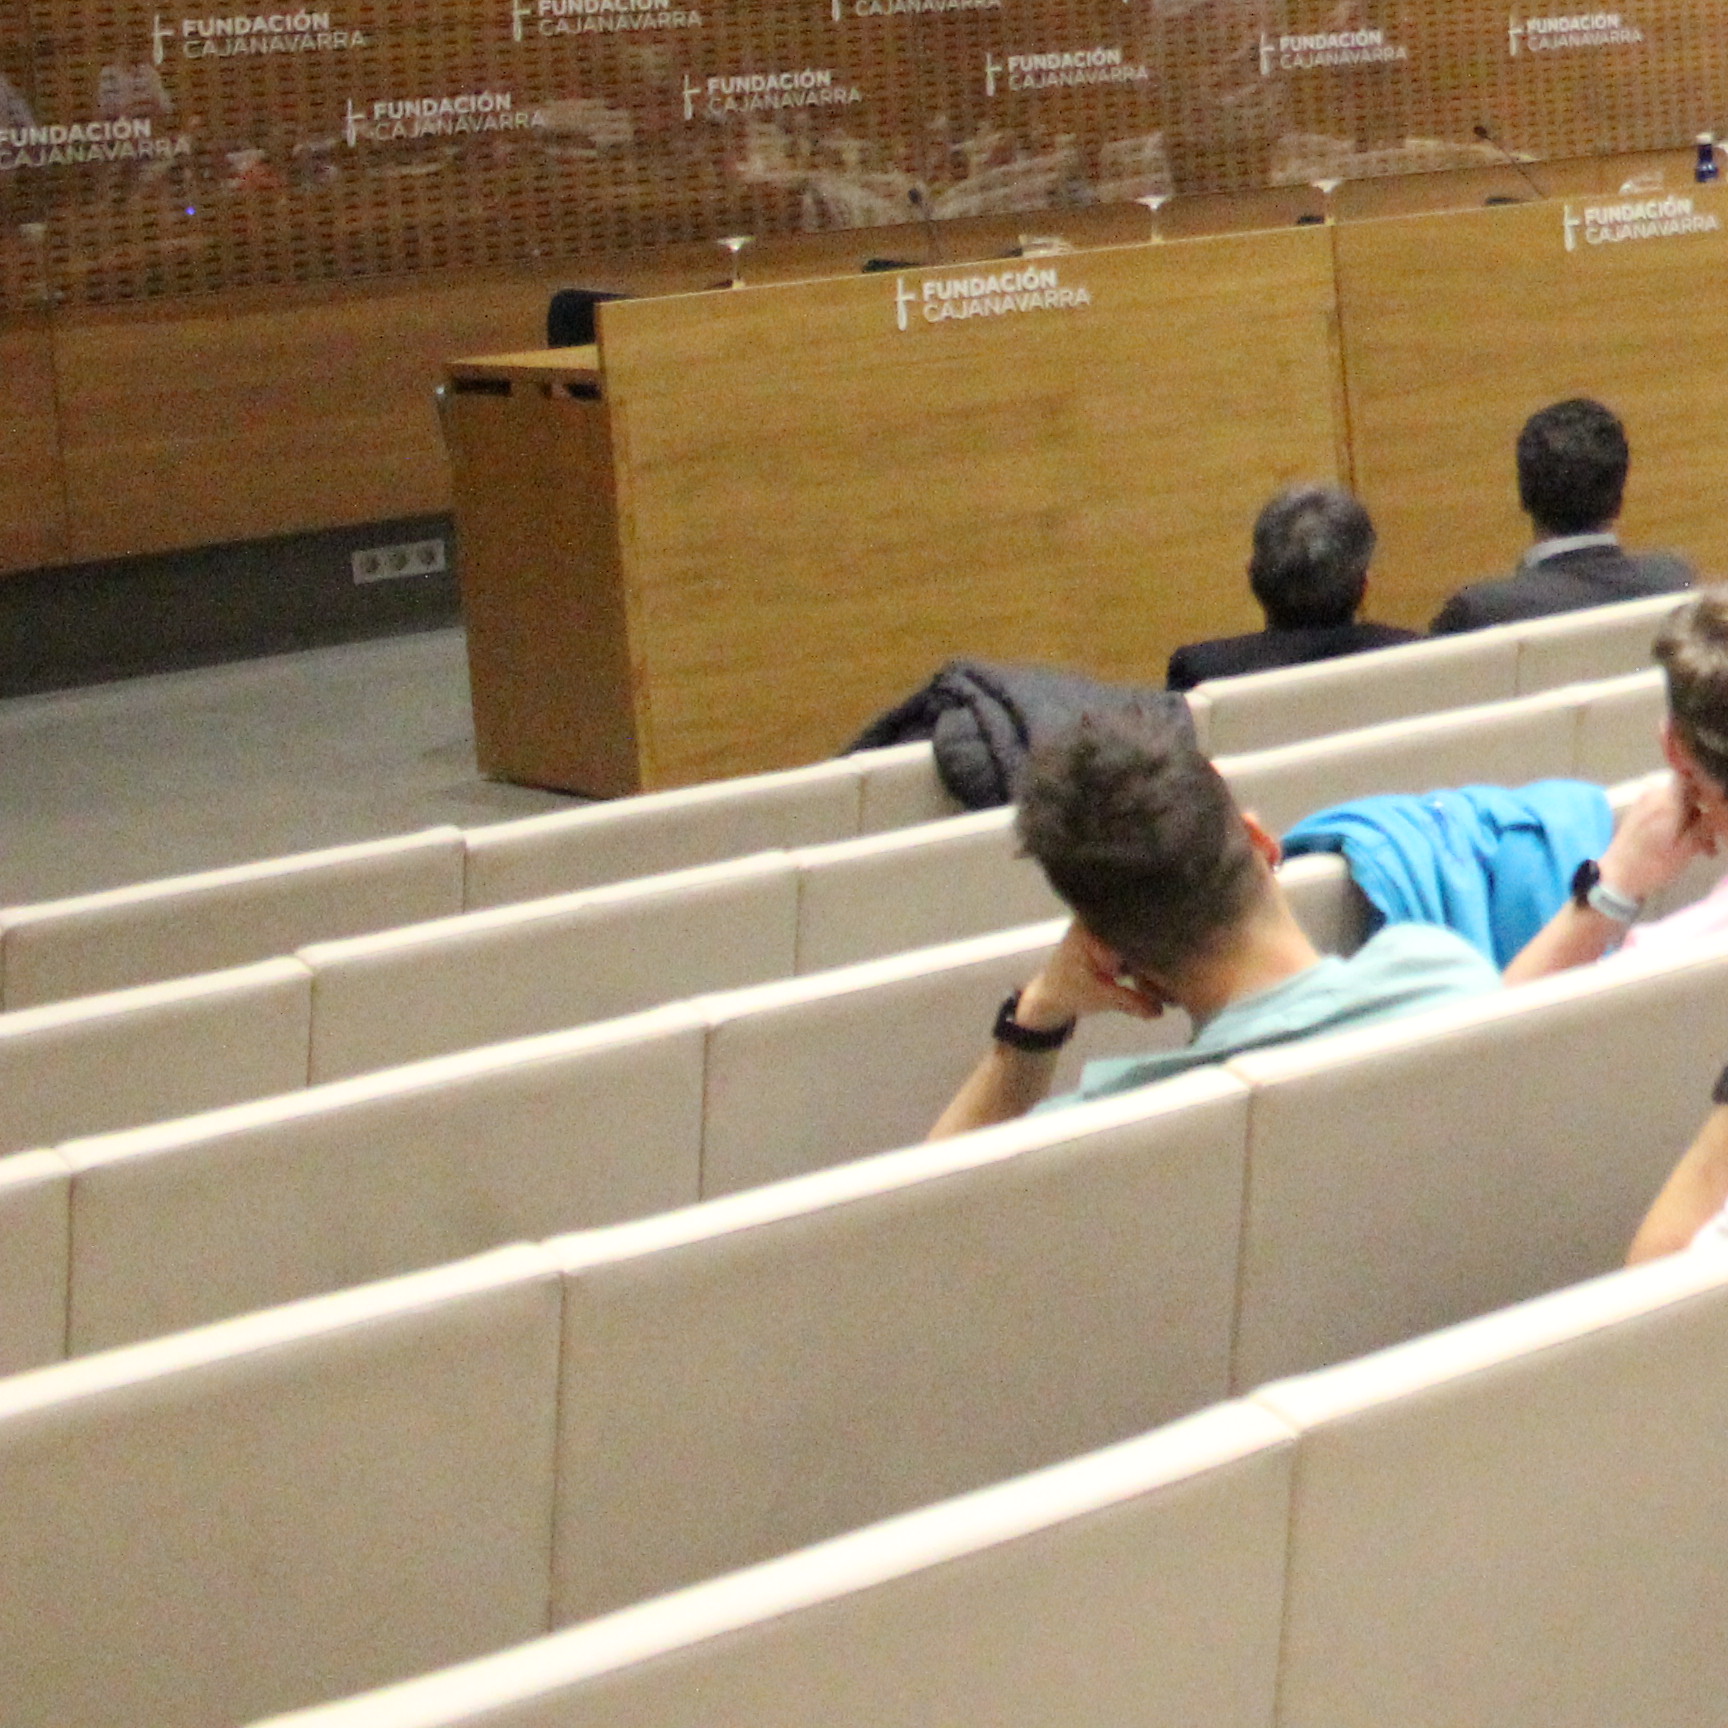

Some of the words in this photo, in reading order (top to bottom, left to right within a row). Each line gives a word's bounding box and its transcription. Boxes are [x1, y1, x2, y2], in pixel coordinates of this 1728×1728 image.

[182, 10, 331, 37] FUNDACIÓN
[539, 10, 700, 37] CAJANAVARRA
[1526, 12, 1621, 34] FUNDACIÓN
[183, 29, 365, 59] CAJANAVARRA
[1279, 28, 1383, 50] FUNDACIÓN
[1527, 29, 1643, 52] CAJANAVARRA
[1008, 46, 1120, 70] FUNDACIÓN
[1280, 46, 1407, 71] CAJANAVARRA
[708, 68, 832, 93] FUNDACIÓN
[1009, 66, 1149, 92] CAJANAVARRA
[373, 91, 511, 121] FUNDACIÓN
[708, 88, 861, 115] CAJANAVARRA
[374, 110, 546, 143] CAJANAVARRA
[1584, 195, 1693, 225] FUNDACIÓN
[1586, 214, 1720, 246] CAJANAVARRA
[922, 264, 1057, 300] FUNDACIÓN
[923, 286, 1090, 323] CAJANAVARRA
